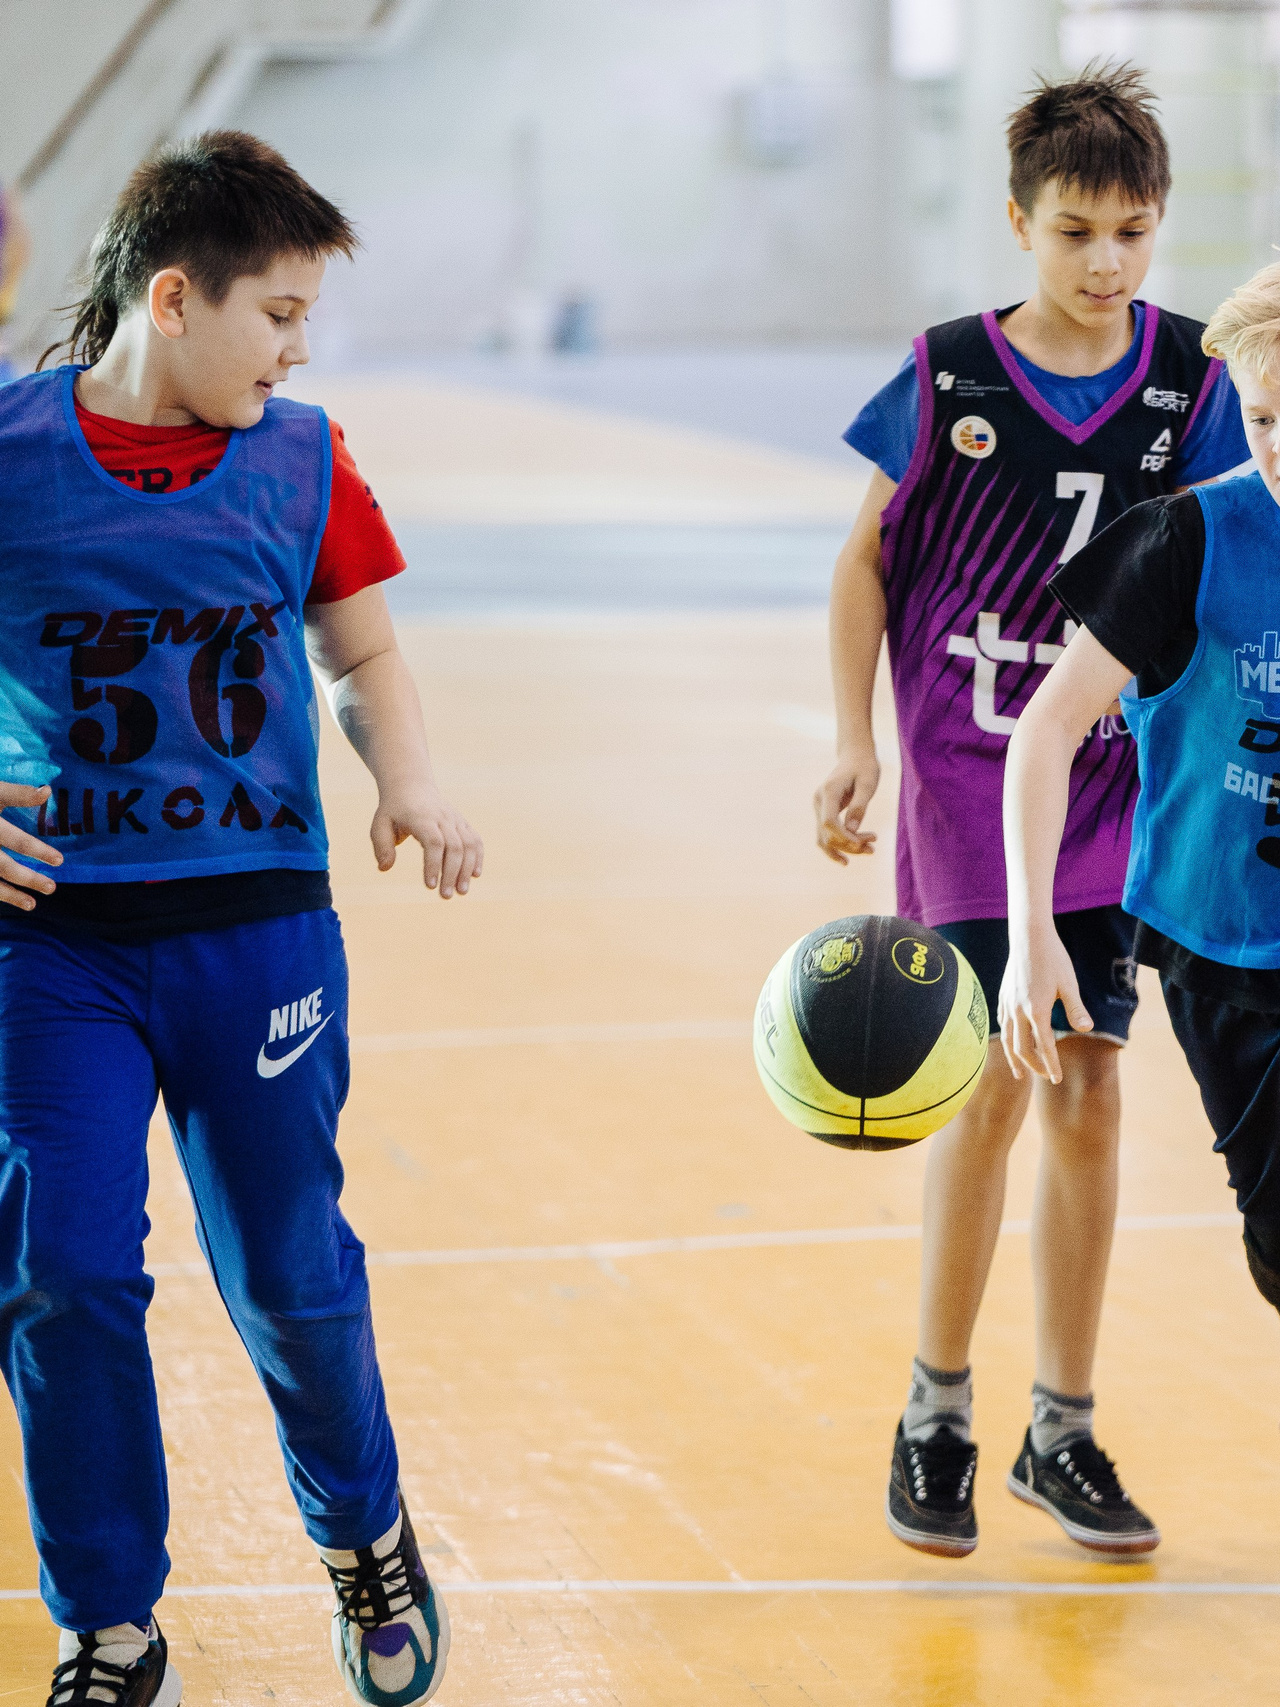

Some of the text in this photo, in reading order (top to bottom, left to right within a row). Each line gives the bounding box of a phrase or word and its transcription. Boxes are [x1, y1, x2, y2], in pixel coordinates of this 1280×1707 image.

[1056, 472, 1105, 565] 7
[40, 602, 287, 647] DEMIX
[69, 637, 267, 765] 56
[267, 986, 323, 1044] NIKE
